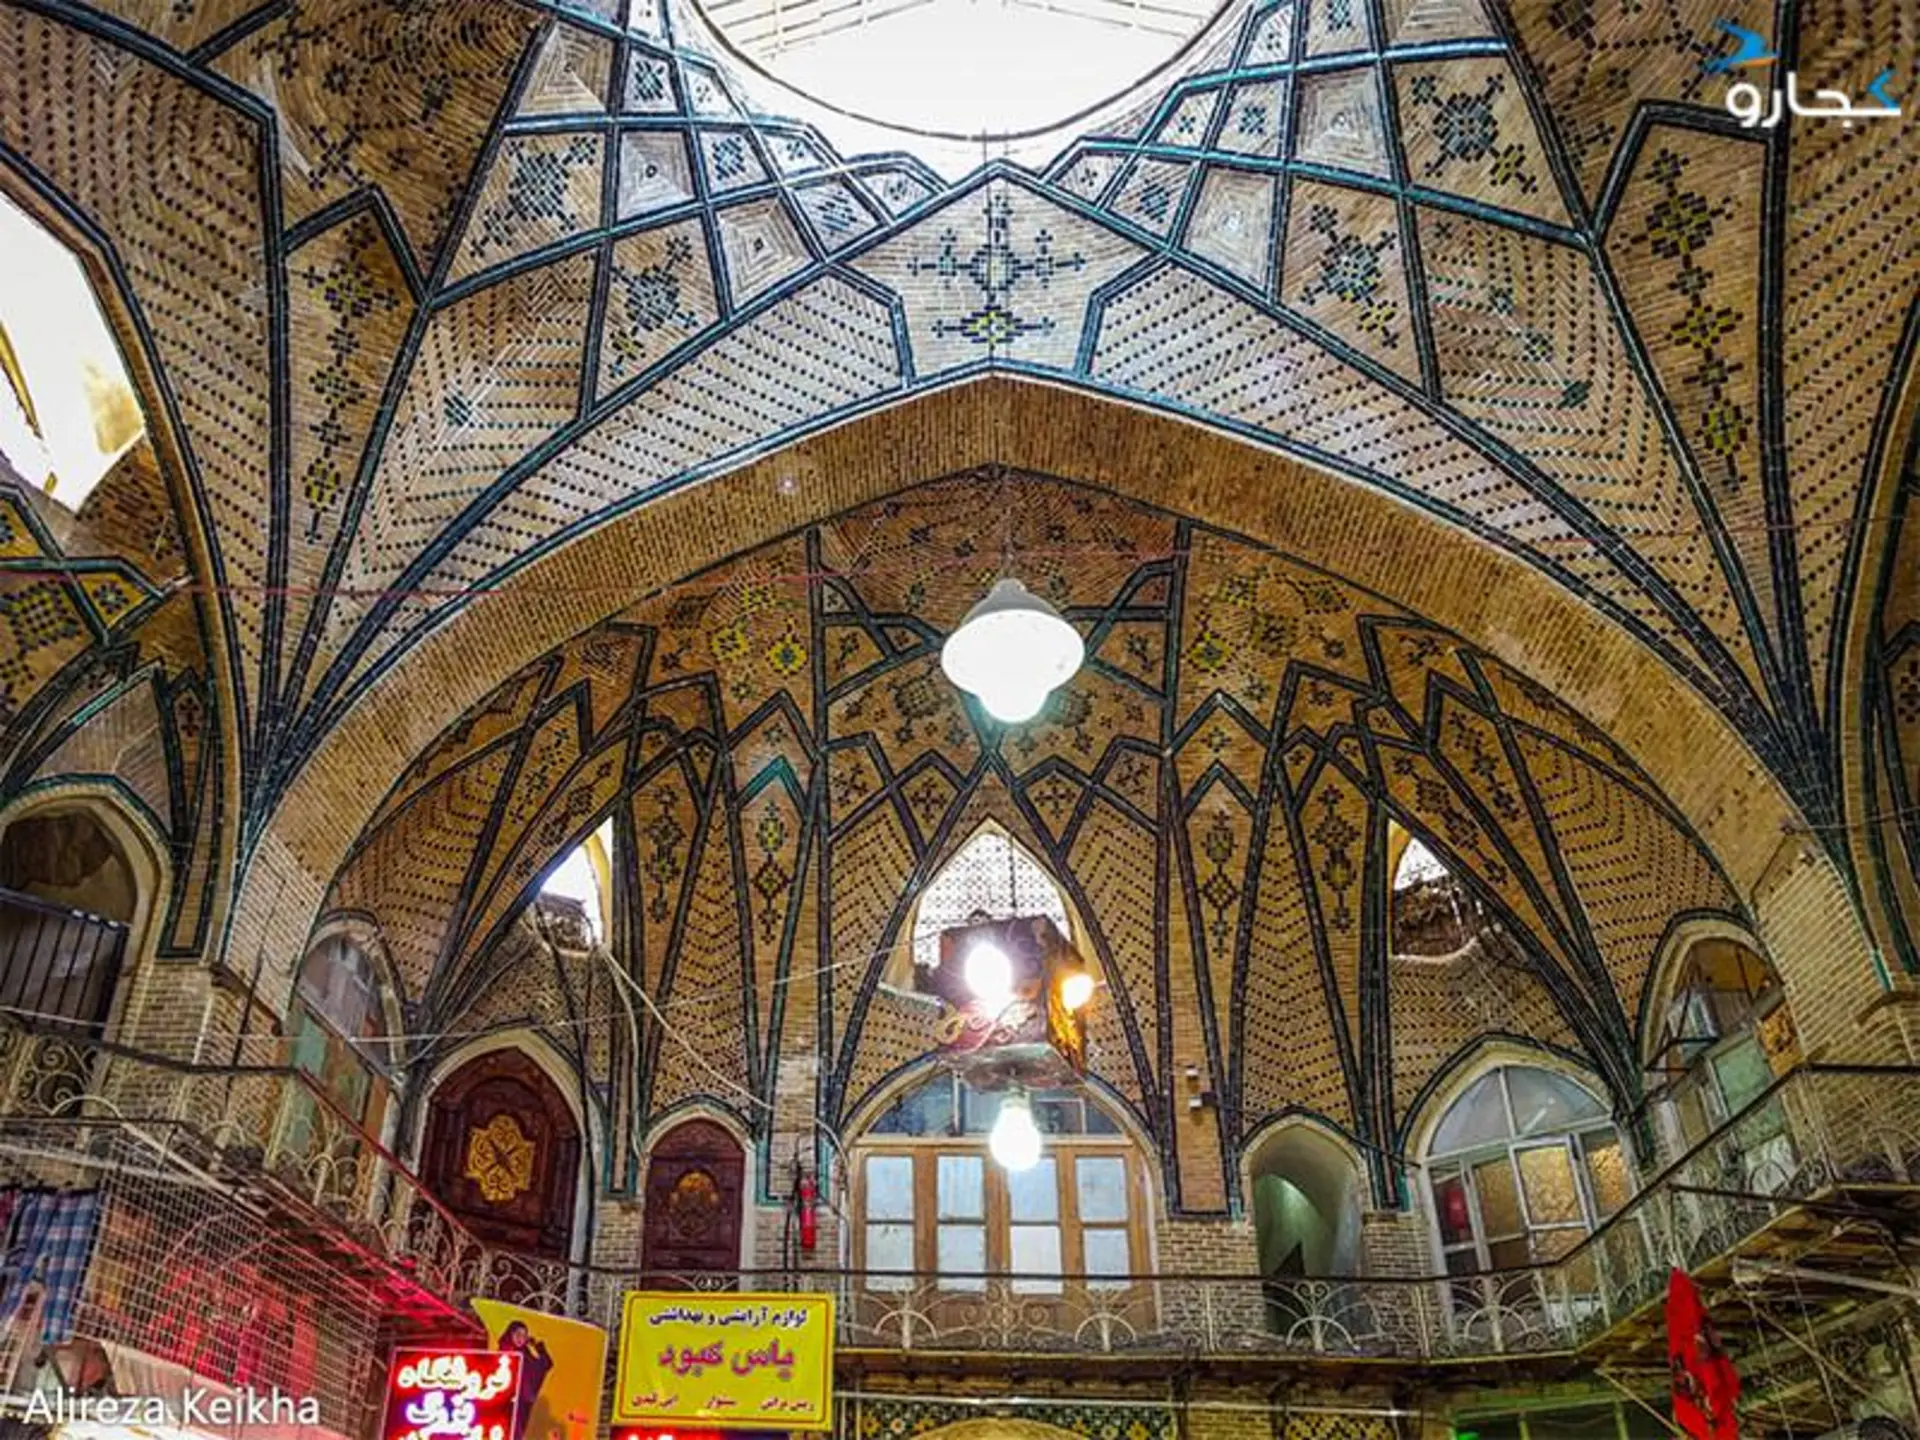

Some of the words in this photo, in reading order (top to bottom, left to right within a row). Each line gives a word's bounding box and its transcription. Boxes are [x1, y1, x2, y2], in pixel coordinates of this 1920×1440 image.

[649, 1307, 703, 1326] بهداشتی
[707, 1311, 716, 1326] و
[719, 1306, 768, 1326] آرایشی
[771, 1308, 807, 1327] لوازم
[658, 1340, 724, 1377] کبود
[731, 1338, 796, 1381] یاس
[397, 1354, 512, 1400] فروشگاه
[405, 1391, 476, 1437] بزرگ
